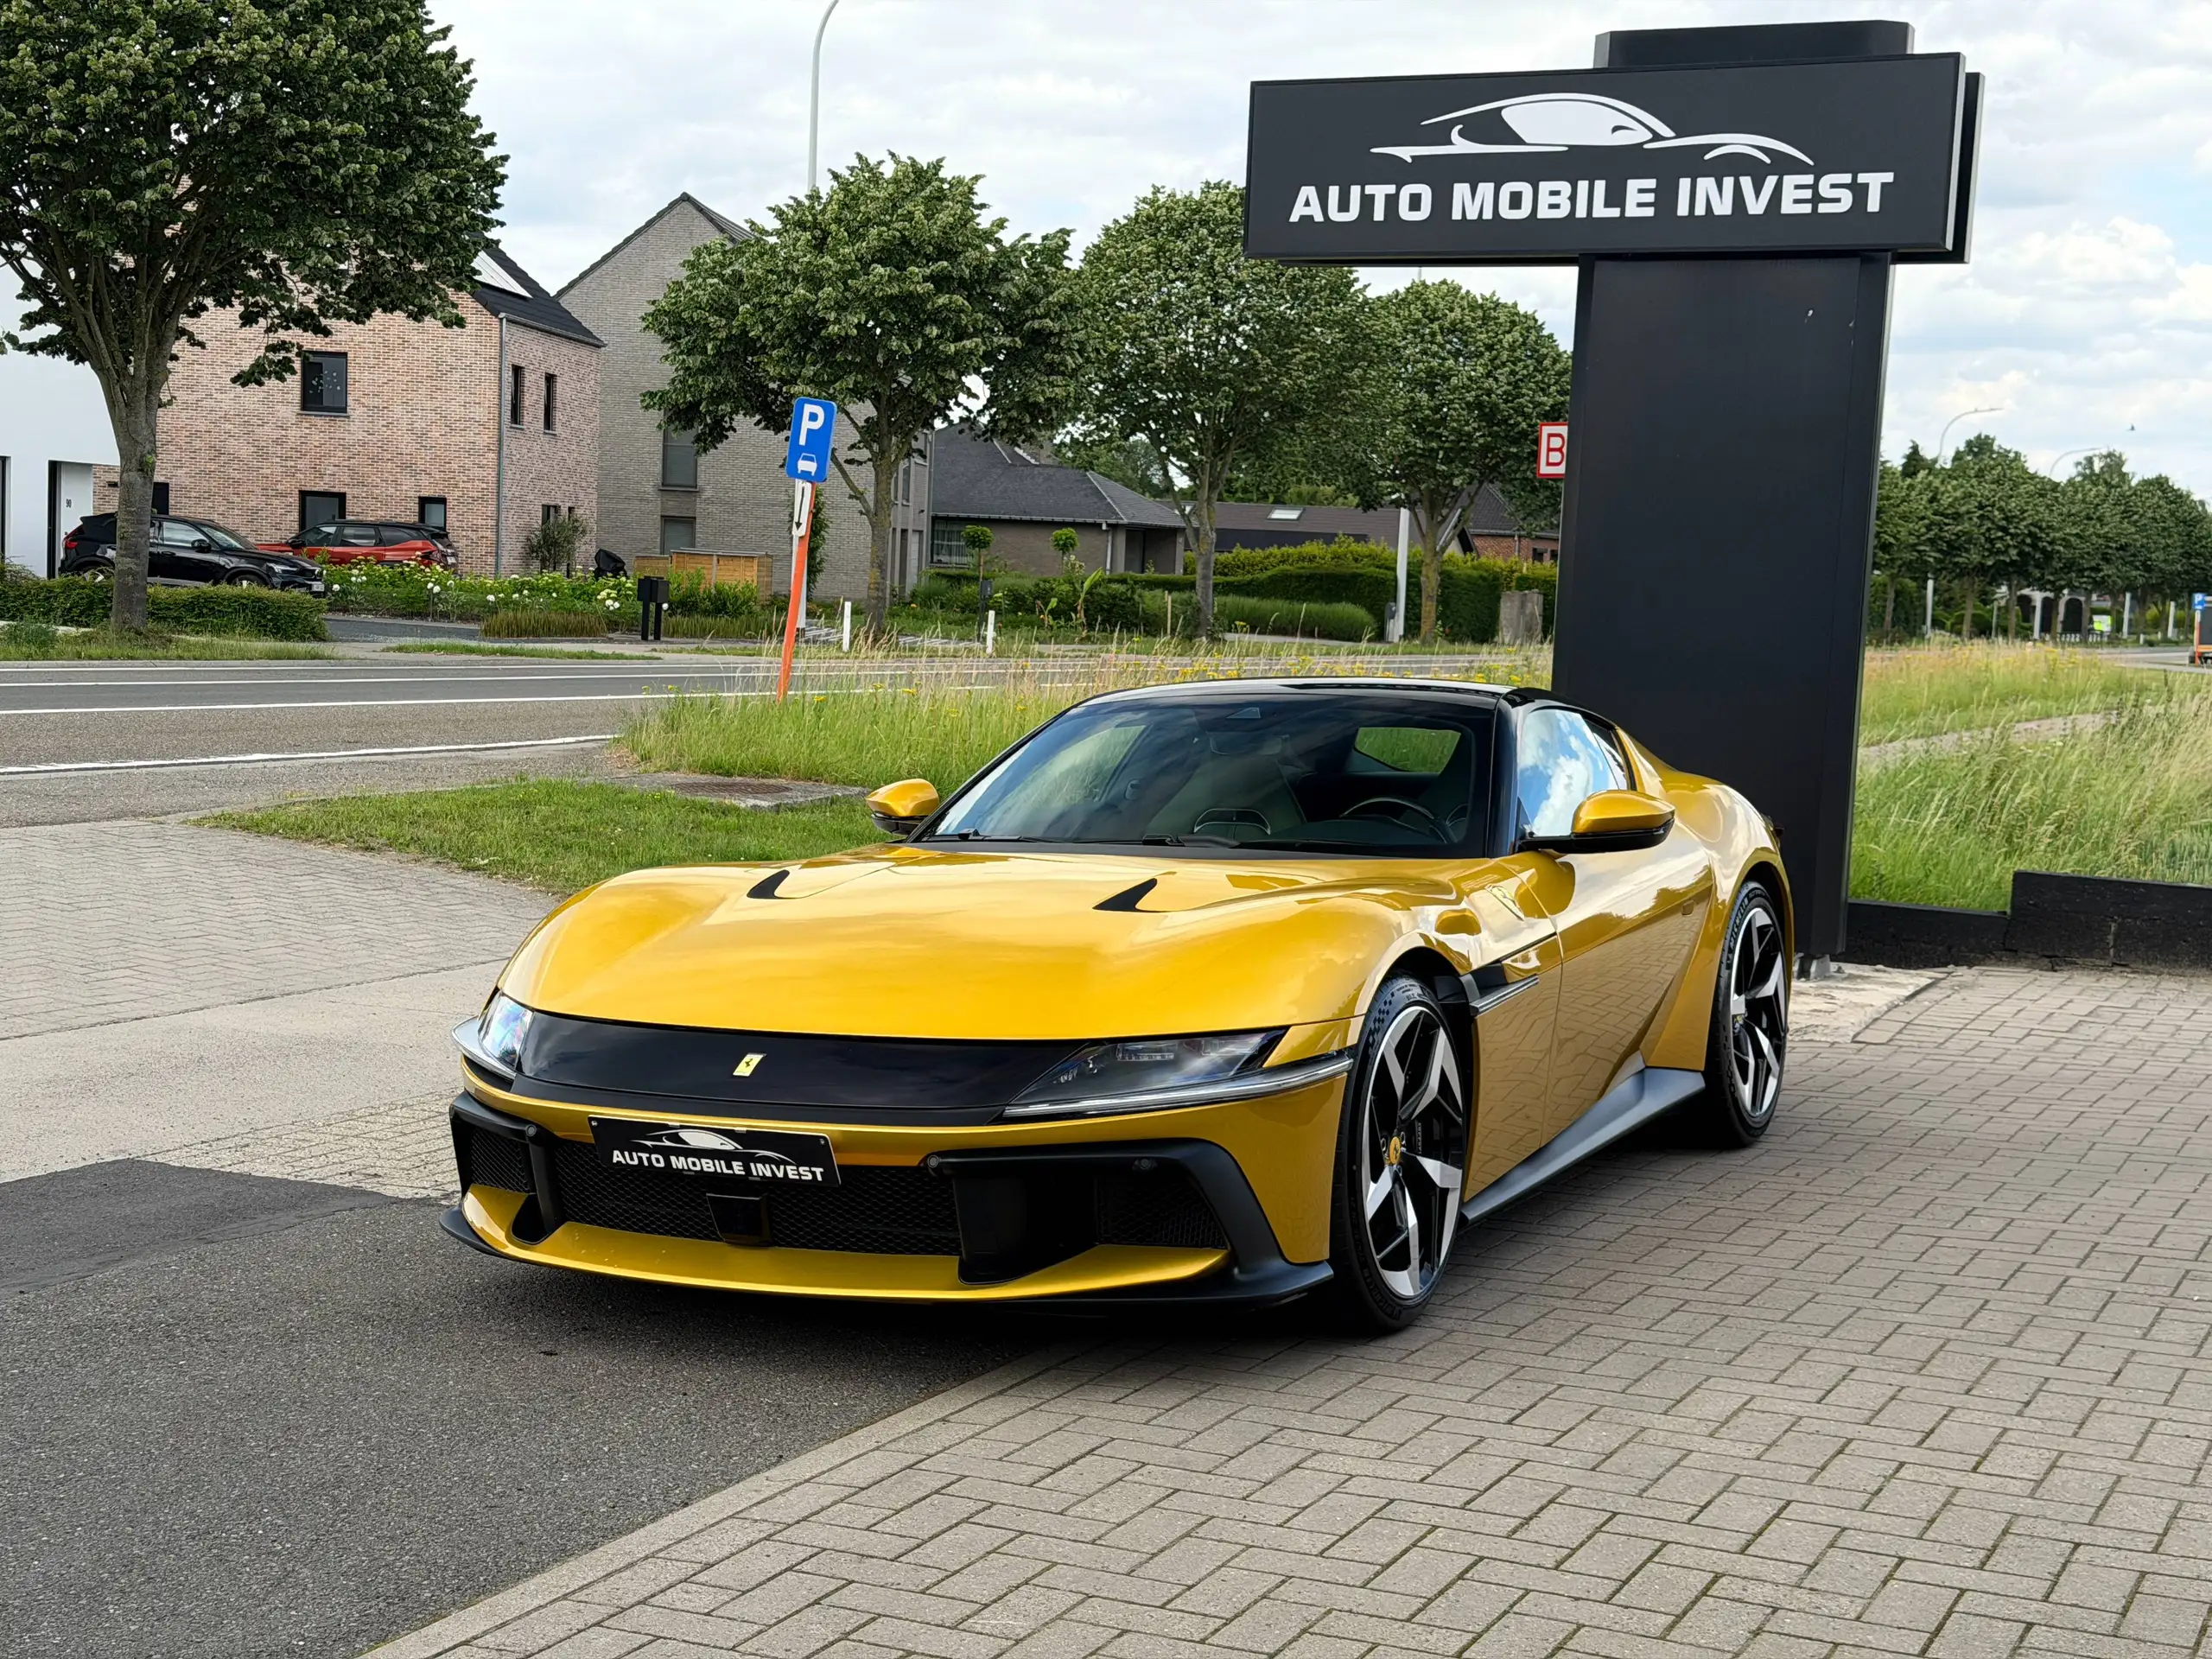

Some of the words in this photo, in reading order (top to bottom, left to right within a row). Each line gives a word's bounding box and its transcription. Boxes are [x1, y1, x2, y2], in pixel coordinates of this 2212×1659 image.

[1288, 183, 1433, 223] AUTO
[1451, 178, 1657, 220] MOBILE
[1676, 171, 1895, 217] INVEST
[798, 403, 825, 446] P
[1545, 433, 1566, 467] B
[612, 1150, 665, 1168] AUTO
[670, 1155, 746, 1175] MOBILE
[749, 1162, 825, 1181] INVEST
